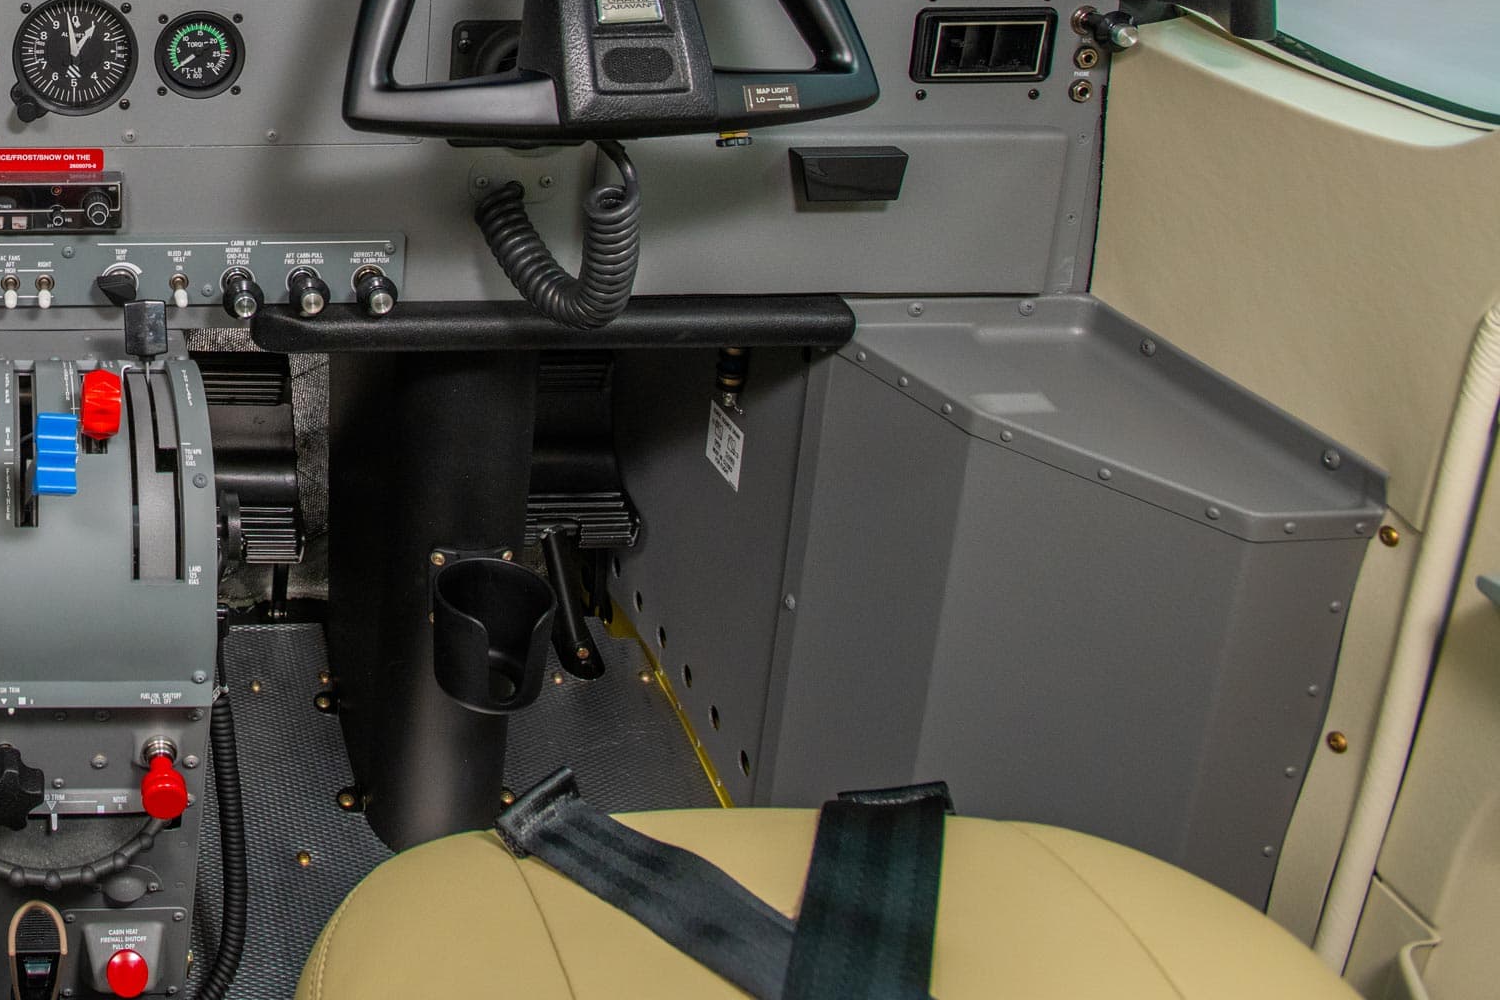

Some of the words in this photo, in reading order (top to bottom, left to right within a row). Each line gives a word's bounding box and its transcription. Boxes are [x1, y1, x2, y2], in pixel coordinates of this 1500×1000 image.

[52, 21, 60, 30] 9
[40, 32, 47, 40] 8
[104, 33, 110, 41] 2
[52, 72, 59, 81] 6
[90, 72, 98, 80] 4
